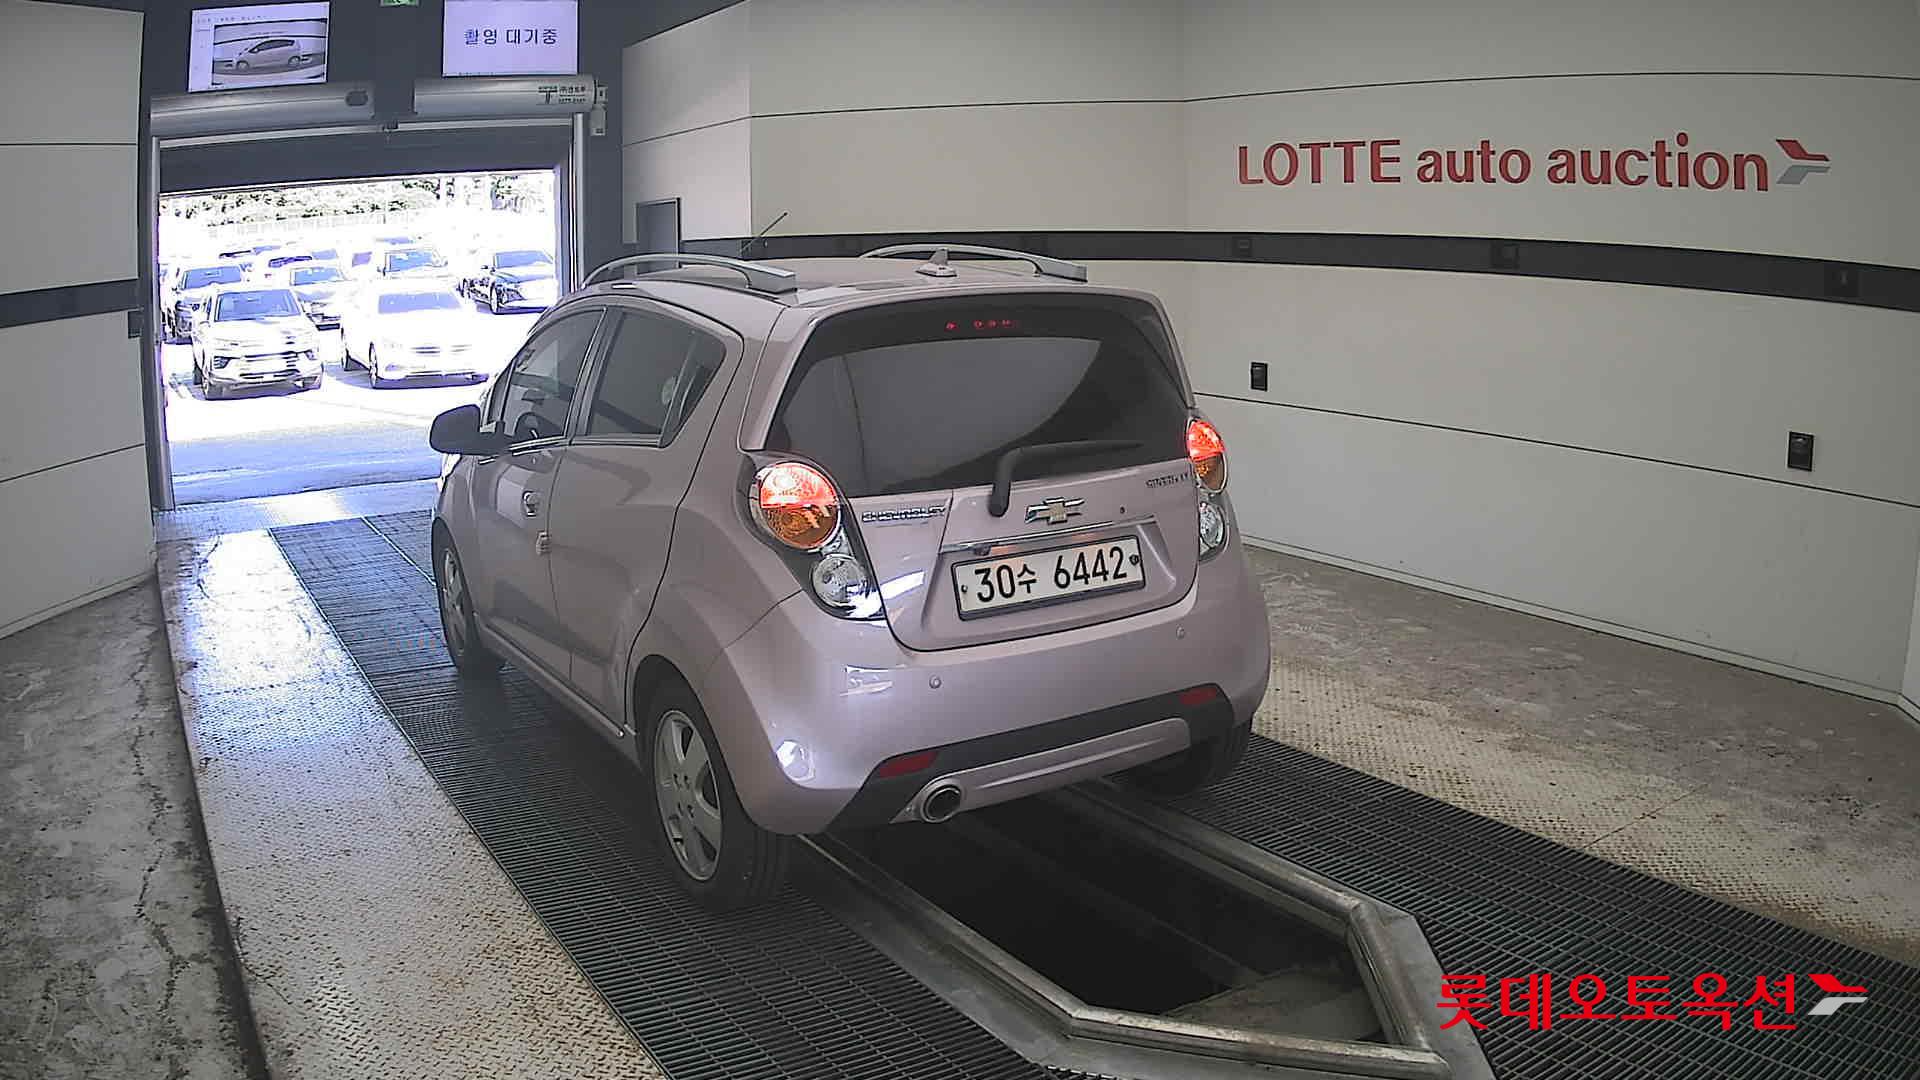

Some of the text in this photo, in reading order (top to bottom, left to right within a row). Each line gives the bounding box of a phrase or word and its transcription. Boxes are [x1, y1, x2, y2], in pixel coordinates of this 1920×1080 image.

[506, 28, 558, 46] 대기중
[1239, 132, 1769, 191] LOTTE auto auction
[974, 546, 1128, 603] 30수 6442
